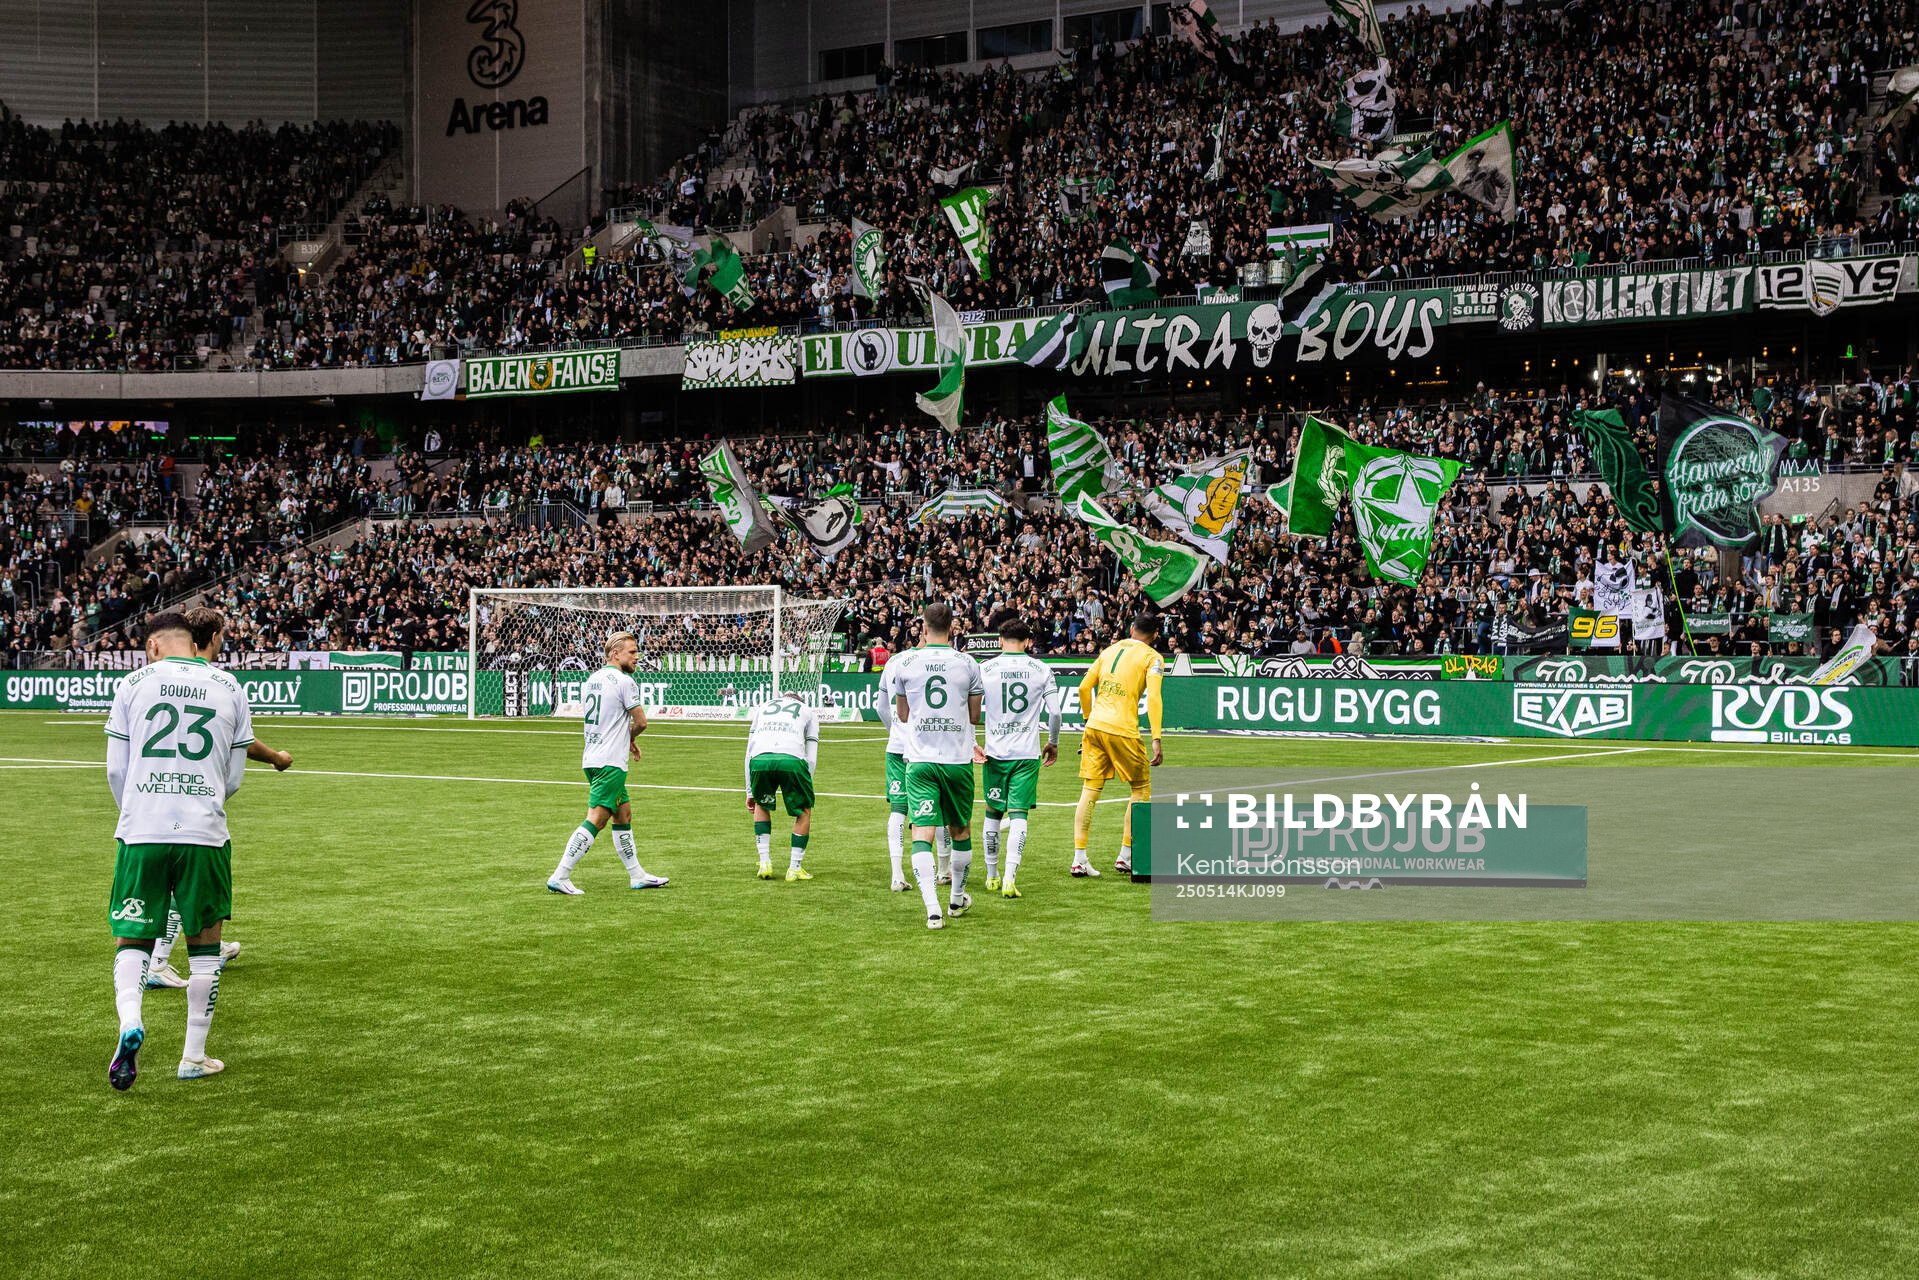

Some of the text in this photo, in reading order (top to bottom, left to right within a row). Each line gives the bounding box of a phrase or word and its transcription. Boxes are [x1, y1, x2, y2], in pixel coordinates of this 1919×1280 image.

[446, 96, 548, 137] Arena
[1453, 283, 1499, 292] ULTRA BOYS
[1761, 267, 1803, 298] 12
[1454, 291, 1498, 305] 116
[1543, 266, 1752, 324] KOLLEKTIVET
[1453, 305, 1496, 316] SOFIA
[1296, 295, 1443, 362] BOYS
[1500, 316, 1535, 331] FOREVER
[469, 354, 605, 393] BAJEN FANS
[1780, 478, 1821, 493] A135
[1675, 484, 1728, 524] från
[1571, 615, 1618, 639] 96
[1110, 648, 1125, 673] 1
[1445, 655, 1498, 674] ULTRAS
[374, 672, 468, 701] PROJOB
[1000, 671, 1030, 679] TOUNEKTI
[160, 684, 208, 701] BOUDAH
[505, 671, 518, 717] SELECT
[924, 674, 948, 710] 6
[1001, 681, 1029, 714] 18
[374, 703, 468, 713] PROFESSIONAL WORKWEAR
[585, 693, 602, 725] 21
[1217, 686, 1441, 726] RUGU BYGG
[1520, 691, 1625, 734] EXAB
[1711, 684, 1853, 730] RYDS
[141, 702, 217, 762] 23
[915, 724, 962, 732] WELLNESS
[920, 717, 955, 725] NORDIC
[1771, 731, 1851, 745] BILGLAS
[136, 783, 217, 797] WELLNESS
[150, 772, 205, 785] NORDIC
[1404, 858, 1486, 871] WORKWEAR
